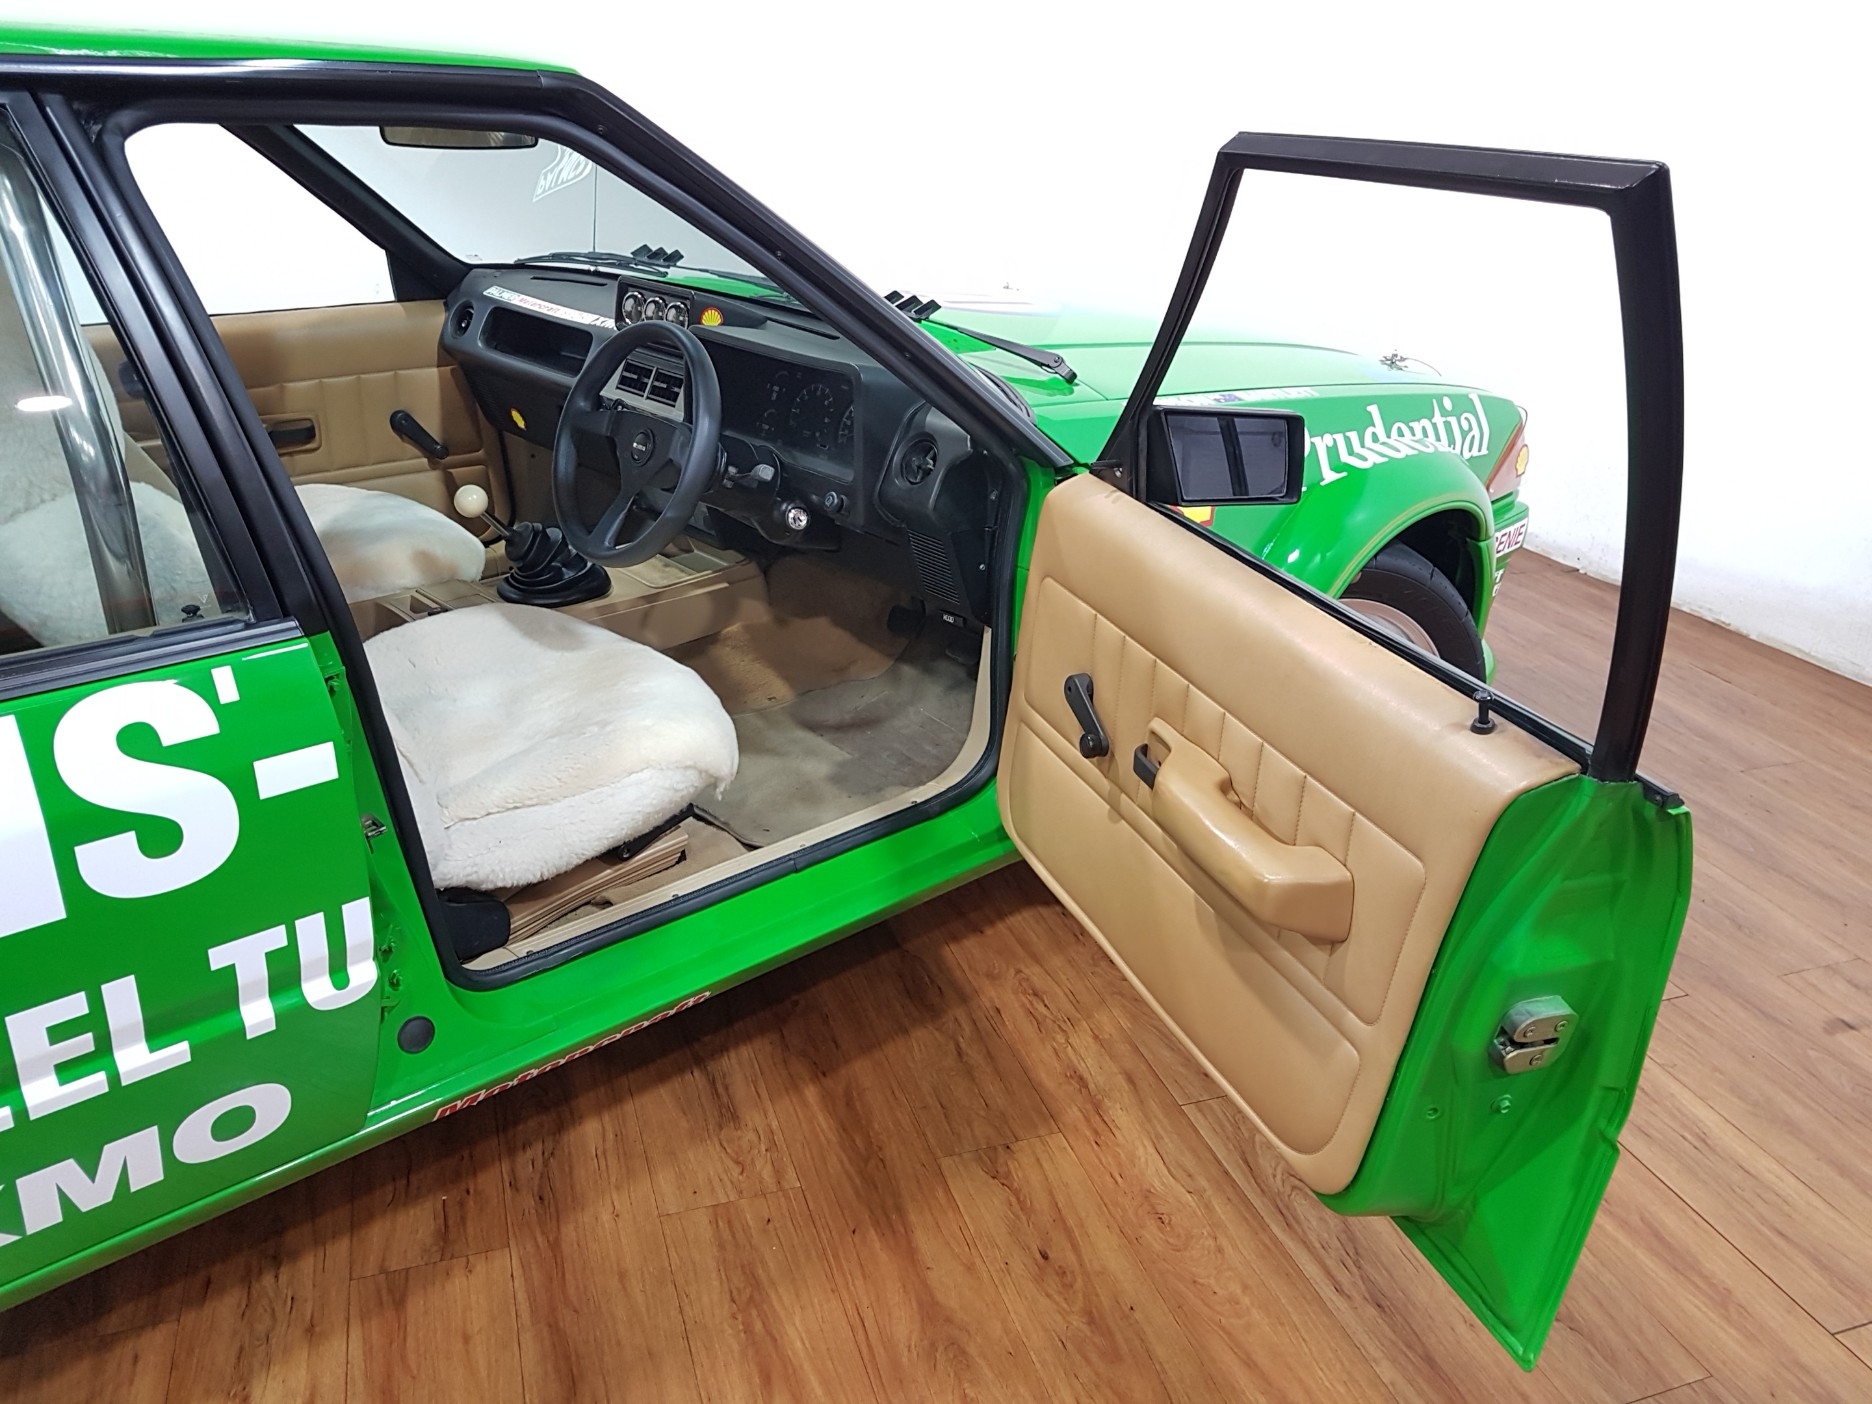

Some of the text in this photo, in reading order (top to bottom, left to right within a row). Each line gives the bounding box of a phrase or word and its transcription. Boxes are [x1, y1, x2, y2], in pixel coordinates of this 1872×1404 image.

[1495, 523, 1526, 555] ENIE
[0, 896, 378, 1133] EL TU
